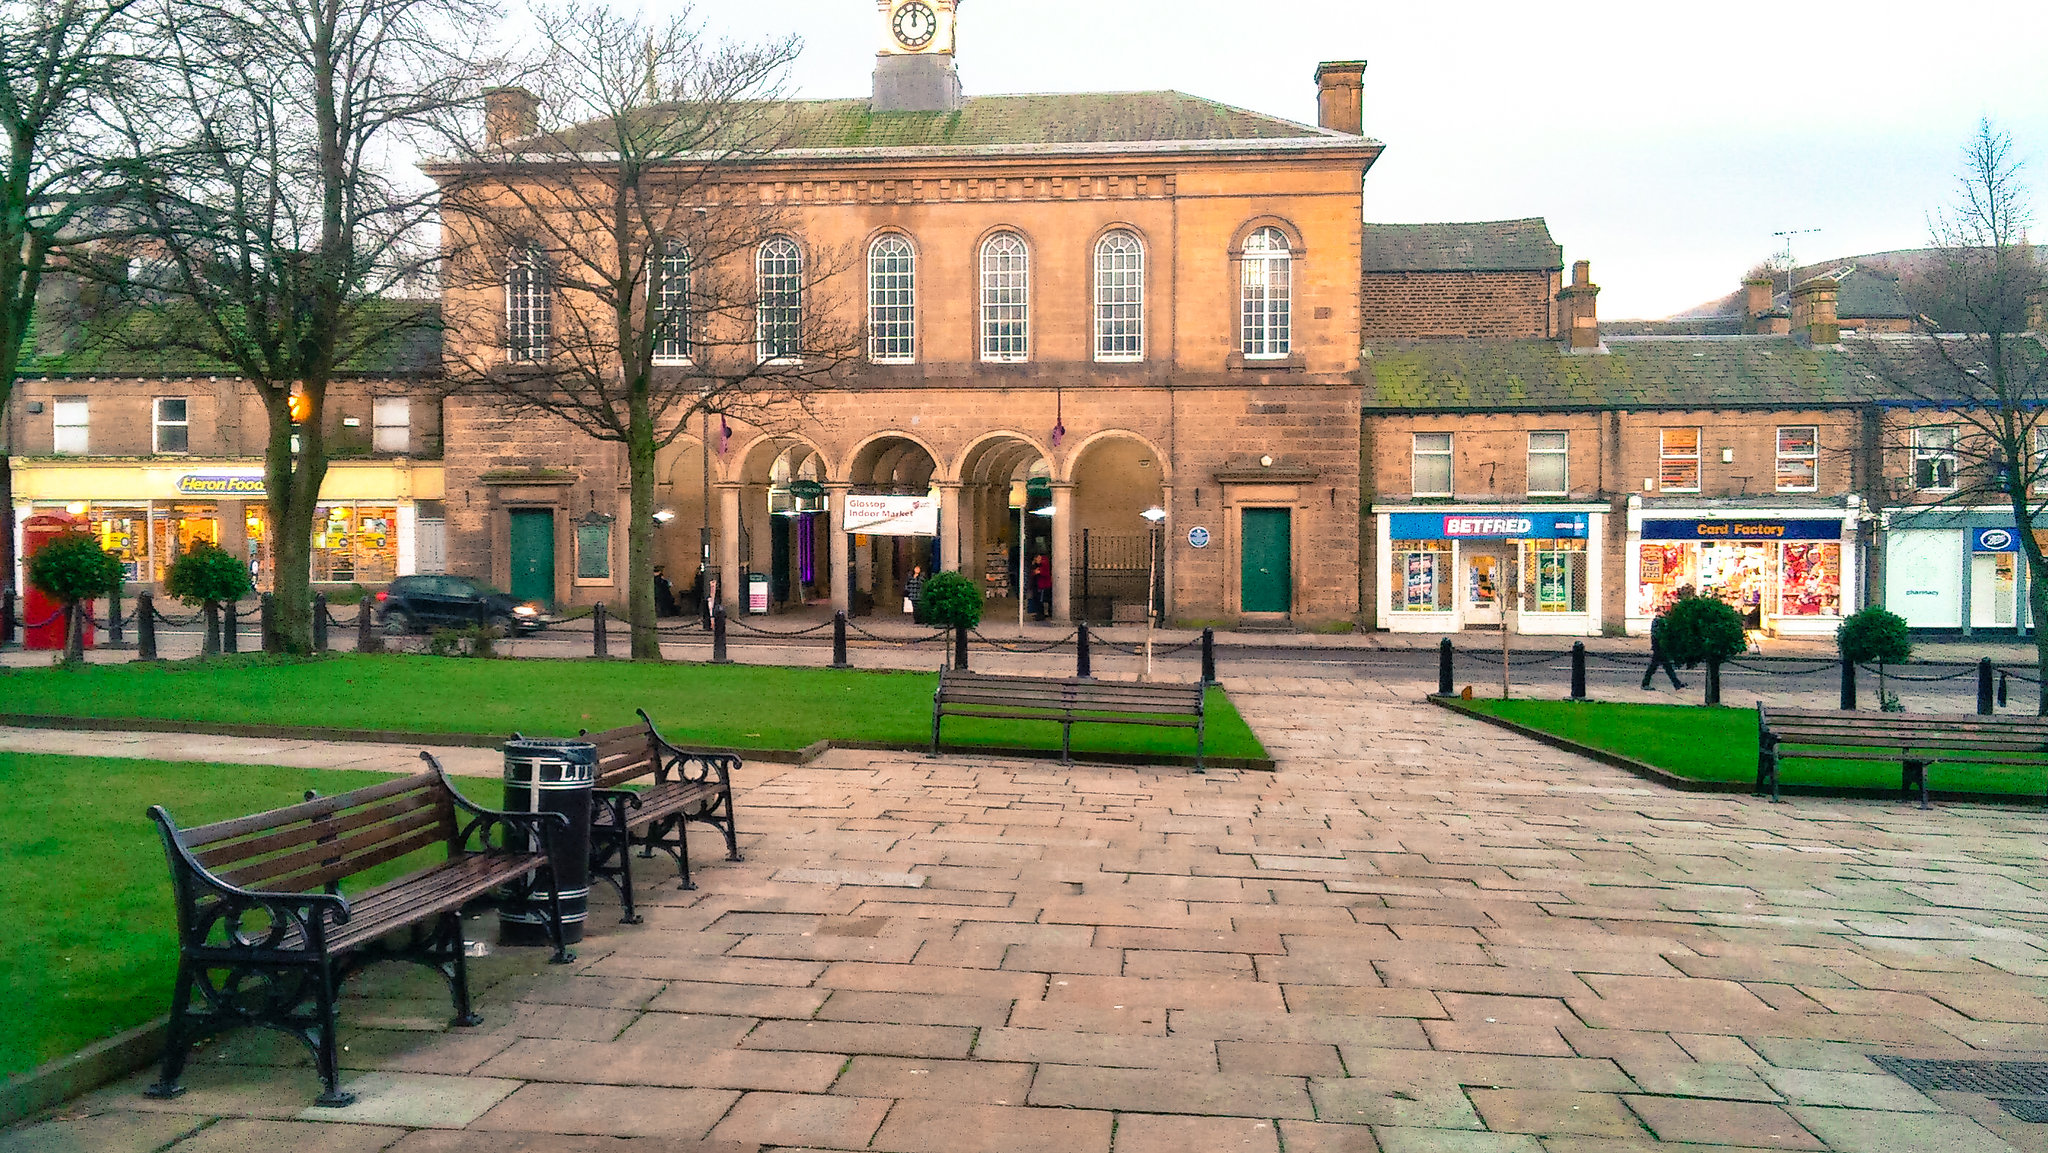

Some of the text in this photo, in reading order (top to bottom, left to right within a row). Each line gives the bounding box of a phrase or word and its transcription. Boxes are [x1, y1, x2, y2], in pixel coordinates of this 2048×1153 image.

[181, 477, 227, 490] Heron
[849, 499, 886, 509] Glossop
[849, 509, 914, 518] Indoor Market
[1447, 518, 1532, 534] BETFRED
[1697, 523, 1785, 537] Card Factory
